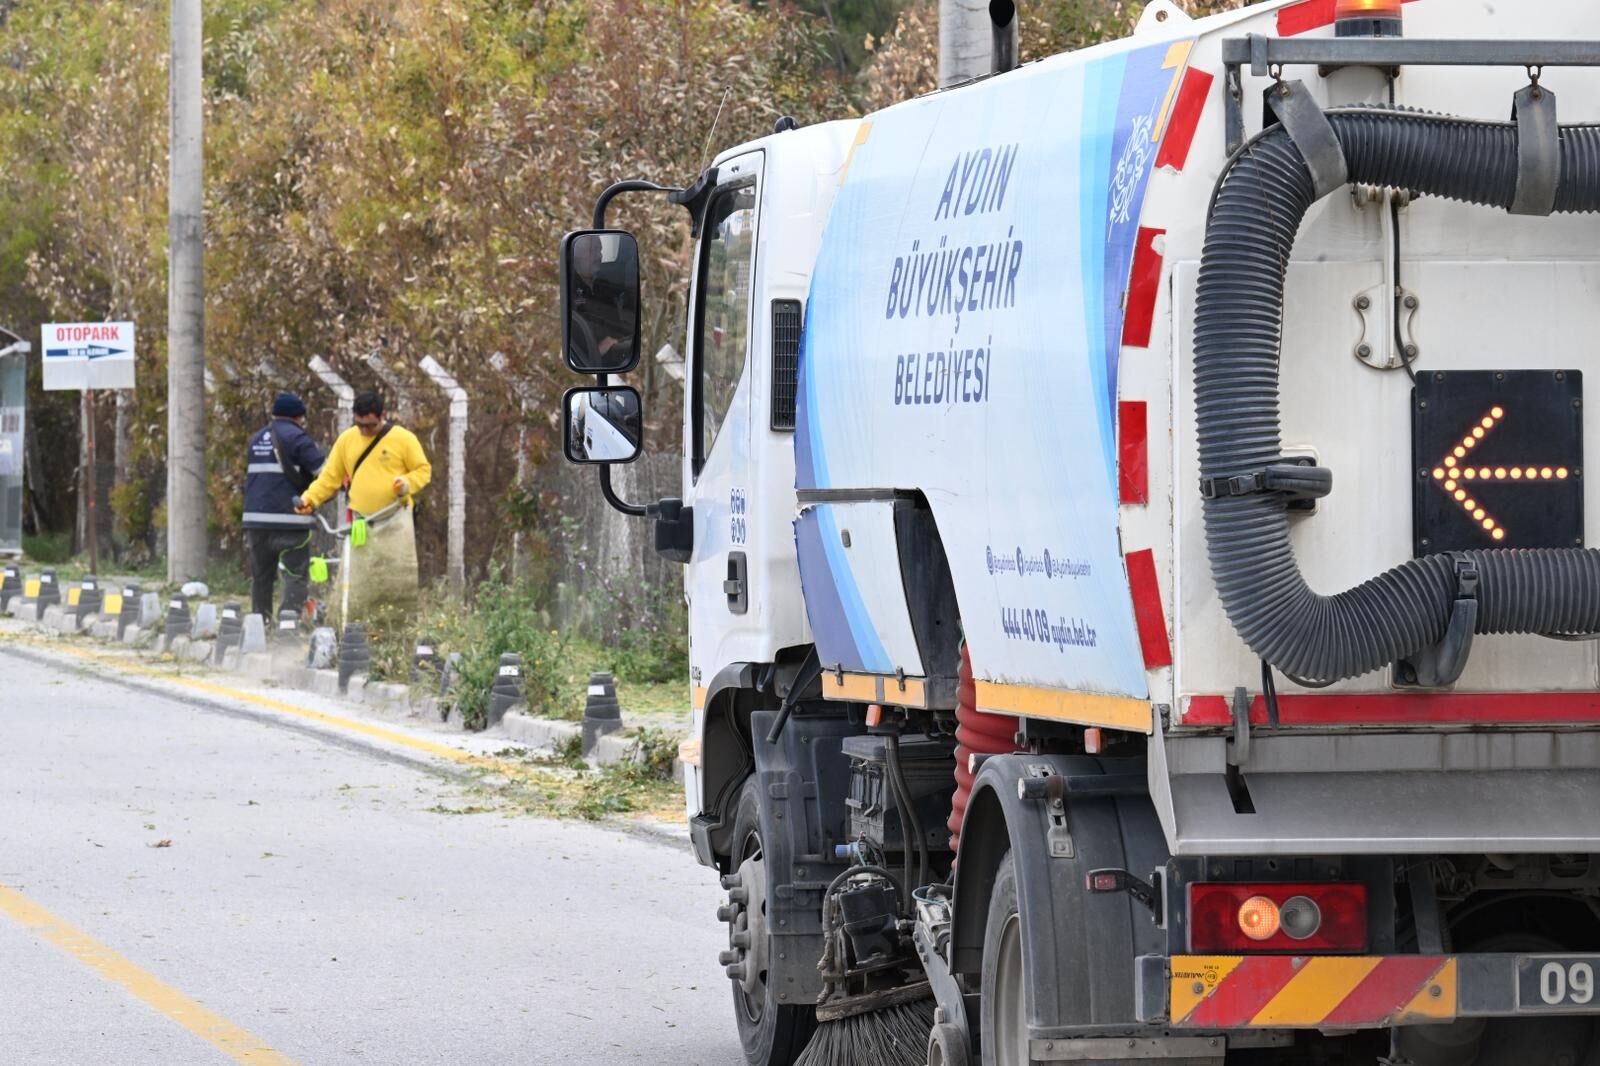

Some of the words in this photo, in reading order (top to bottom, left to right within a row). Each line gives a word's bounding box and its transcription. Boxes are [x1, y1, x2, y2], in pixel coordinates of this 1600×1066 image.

[934, 143, 1019, 222] AYDIN
[886, 225, 1023, 335] BÜYÜKŞEHİR
[56, 326, 119, 342] OTOPARK
[894, 335, 992, 406] BELEDİYESİ
[1001, 607, 1022, 641] 444
[1021, 608, 1036, 642] 40
[1034, 609, 1051, 643] 09
[1540, 961, 1594, 1005] 09
